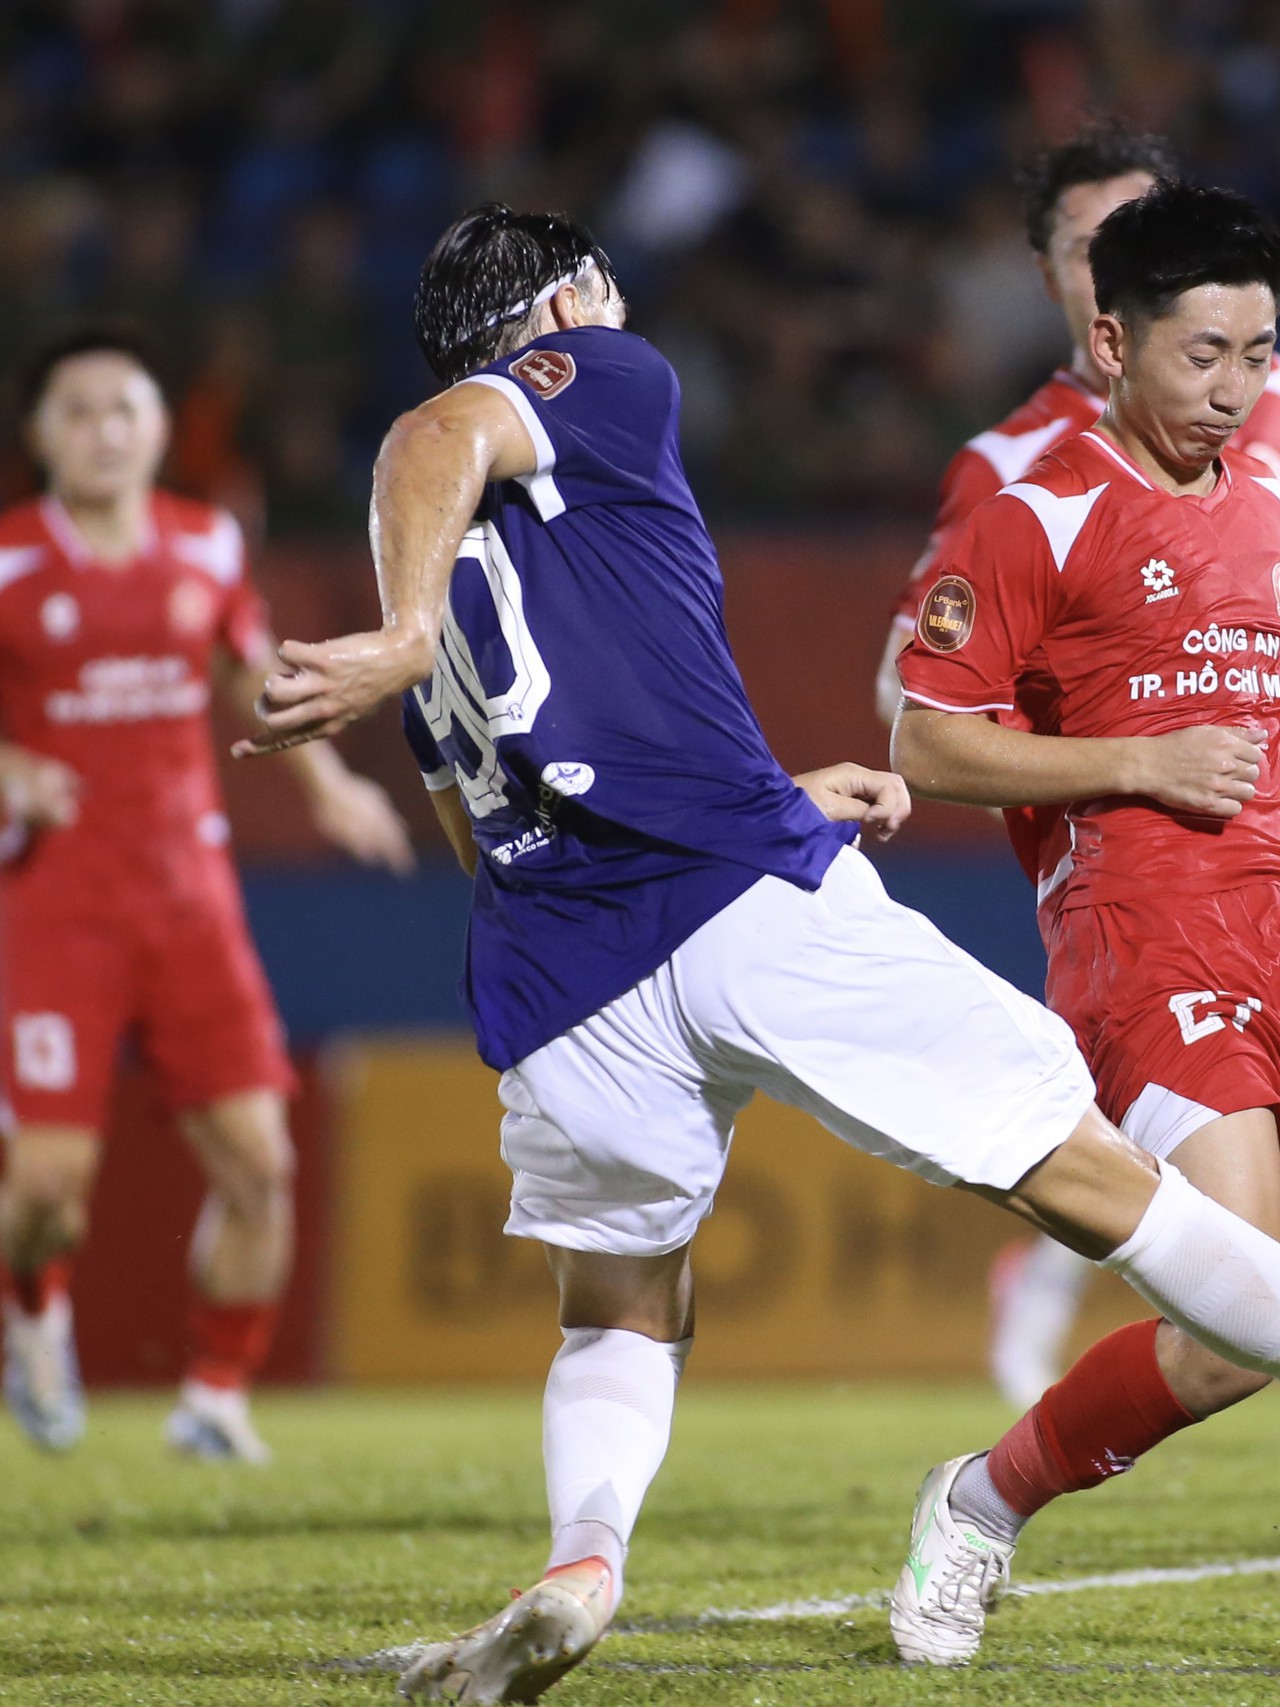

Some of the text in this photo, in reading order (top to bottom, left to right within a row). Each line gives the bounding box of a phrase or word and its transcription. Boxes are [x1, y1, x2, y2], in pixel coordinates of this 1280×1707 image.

[1182, 622, 1280, 660] CÔNG AN
[1128, 673, 1166, 700] TP.
[1176, 659, 1219, 696] HỒ
[1224, 664, 1260, 694] CHÍ
